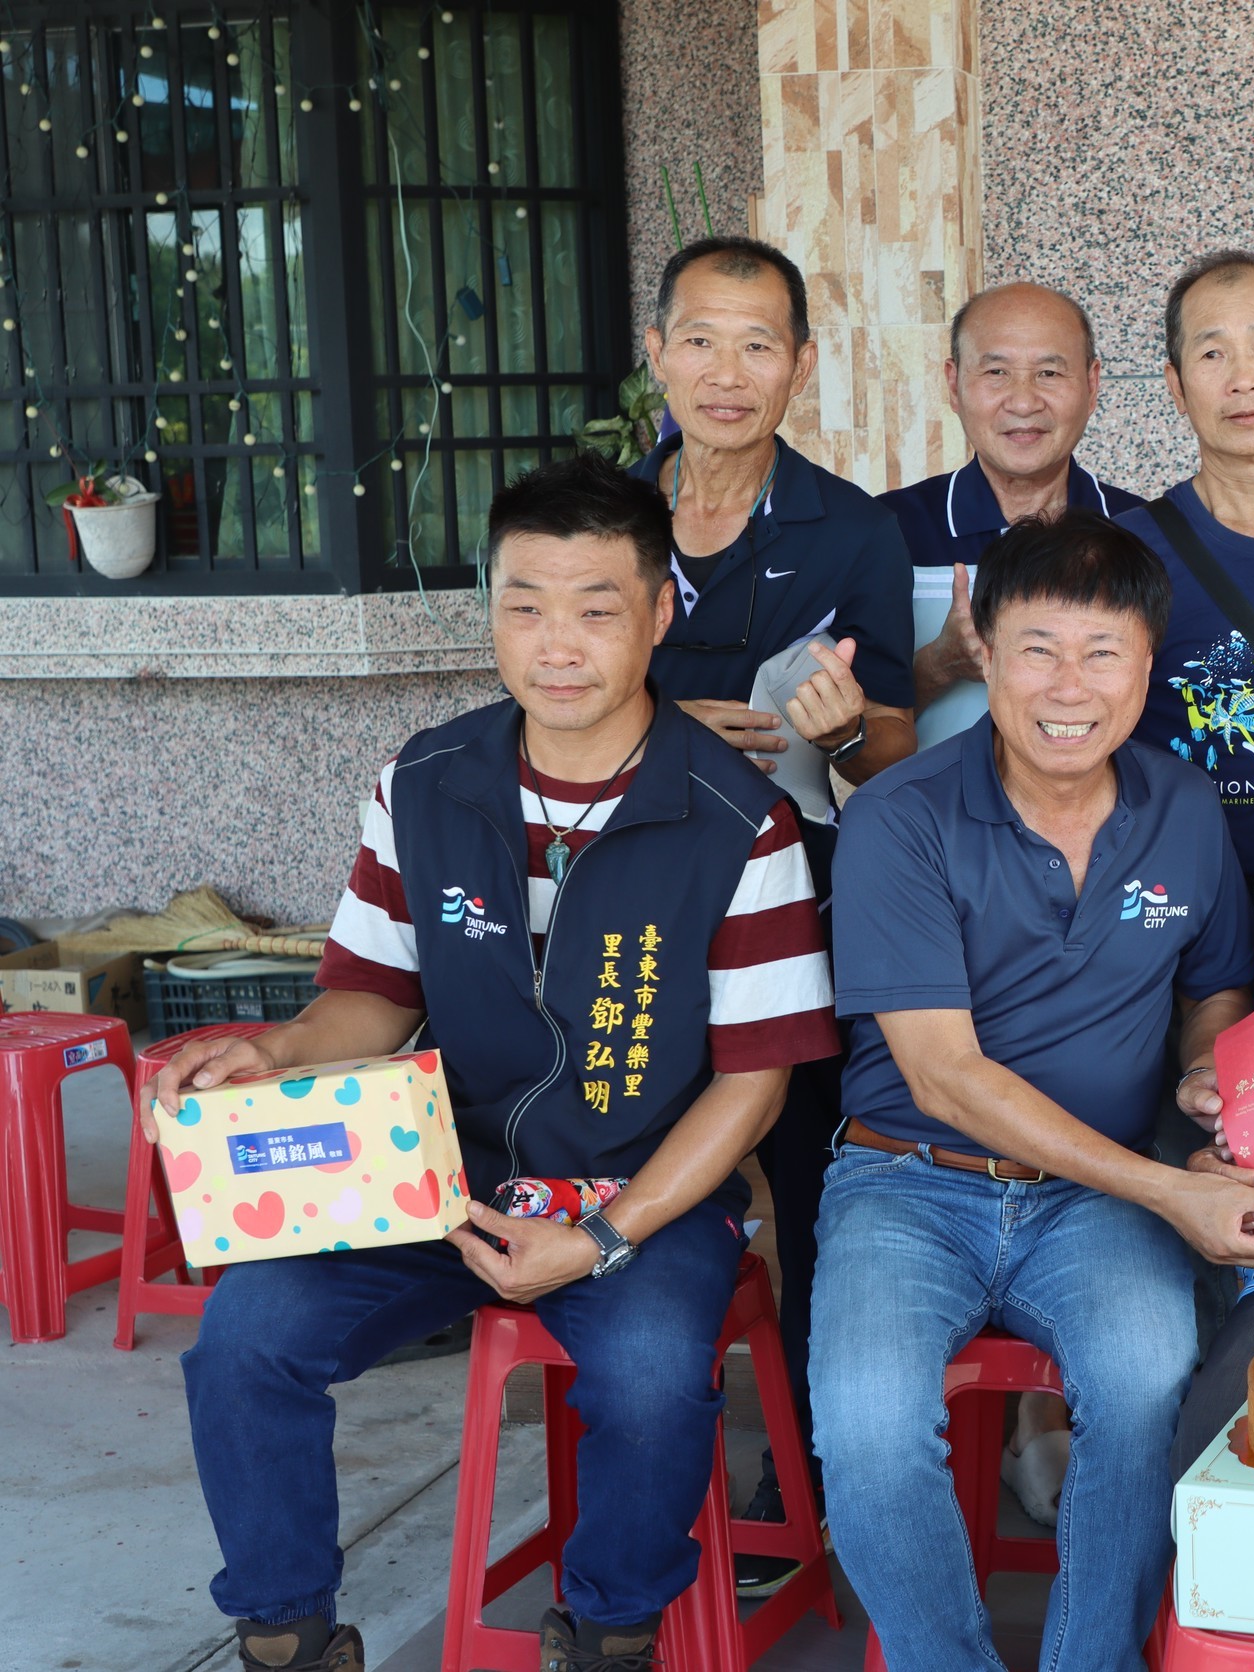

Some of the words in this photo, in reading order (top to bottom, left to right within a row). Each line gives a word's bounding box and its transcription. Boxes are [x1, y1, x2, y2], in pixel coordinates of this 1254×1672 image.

[1221, 797, 1254, 805] MARINE
[1144, 905, 1189, 918] TAITUNG
[464, 915, 508, 935] TAITUNG
[1143, 917, 1167, 929] CITY
[464, 927, 485, 941] CITY
[623, 924, 663, 1097] 臺東市豐樂里
[583, 934, 625, 1114] 里長鄧弘明
[269, 1141, 327, 1165] 陳銘風
